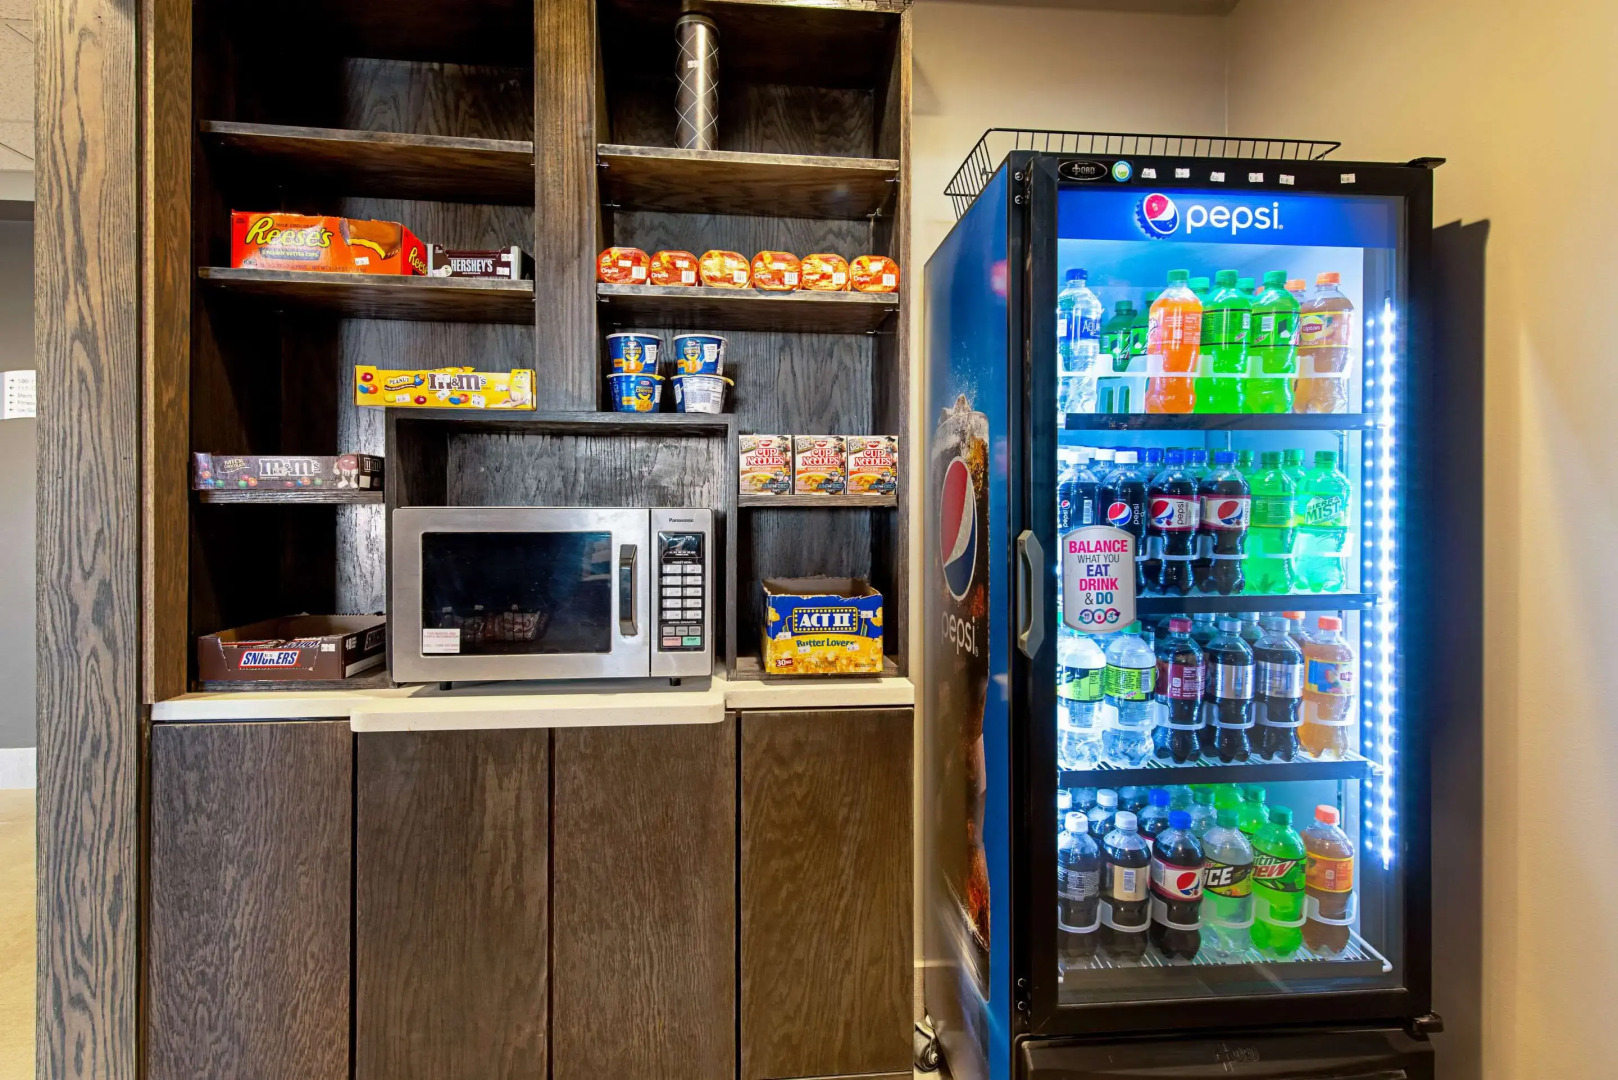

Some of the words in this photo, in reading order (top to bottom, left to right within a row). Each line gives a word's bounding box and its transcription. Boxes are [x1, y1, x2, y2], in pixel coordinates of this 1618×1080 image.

[1187, 202, 1279, 235] pepsi
[245, 216, 334, 248] Reese's
[451, 259, 493, 273] HERSHEY'S
[389, 377, 410, 385] PEANUT
[755, 447, 778, 457] CUP
[811, 447, 833, 457] CUP
[863, 448, 886, 458] CUP
[746, 456, 785, 466] NOODLES
[802, 456, 840, 466] NOODLES
[854, 457, 892, 467] NOODLES
[1132, 503, 1140, 525] pepsi
[1176, 502, 1185, 525] pepsi
[1306, 502, 1340, 522] MIST
[1069, 540, 1128, 553] BALANCE
[1077, 554, 1101, 563] WHAT
[1104, 554, 1120, 563] YOU
[1079, 578, 1118, 591] DRINK
[1085, 592, 1093, 605] &
[1096, 592, 1113, 604] DO
[799, 613, 831, 627] ACT
[832, 613, 851, 627] II
[941, 611, 976, 655] pepsi
[796, 639, 825, 648] Butter
